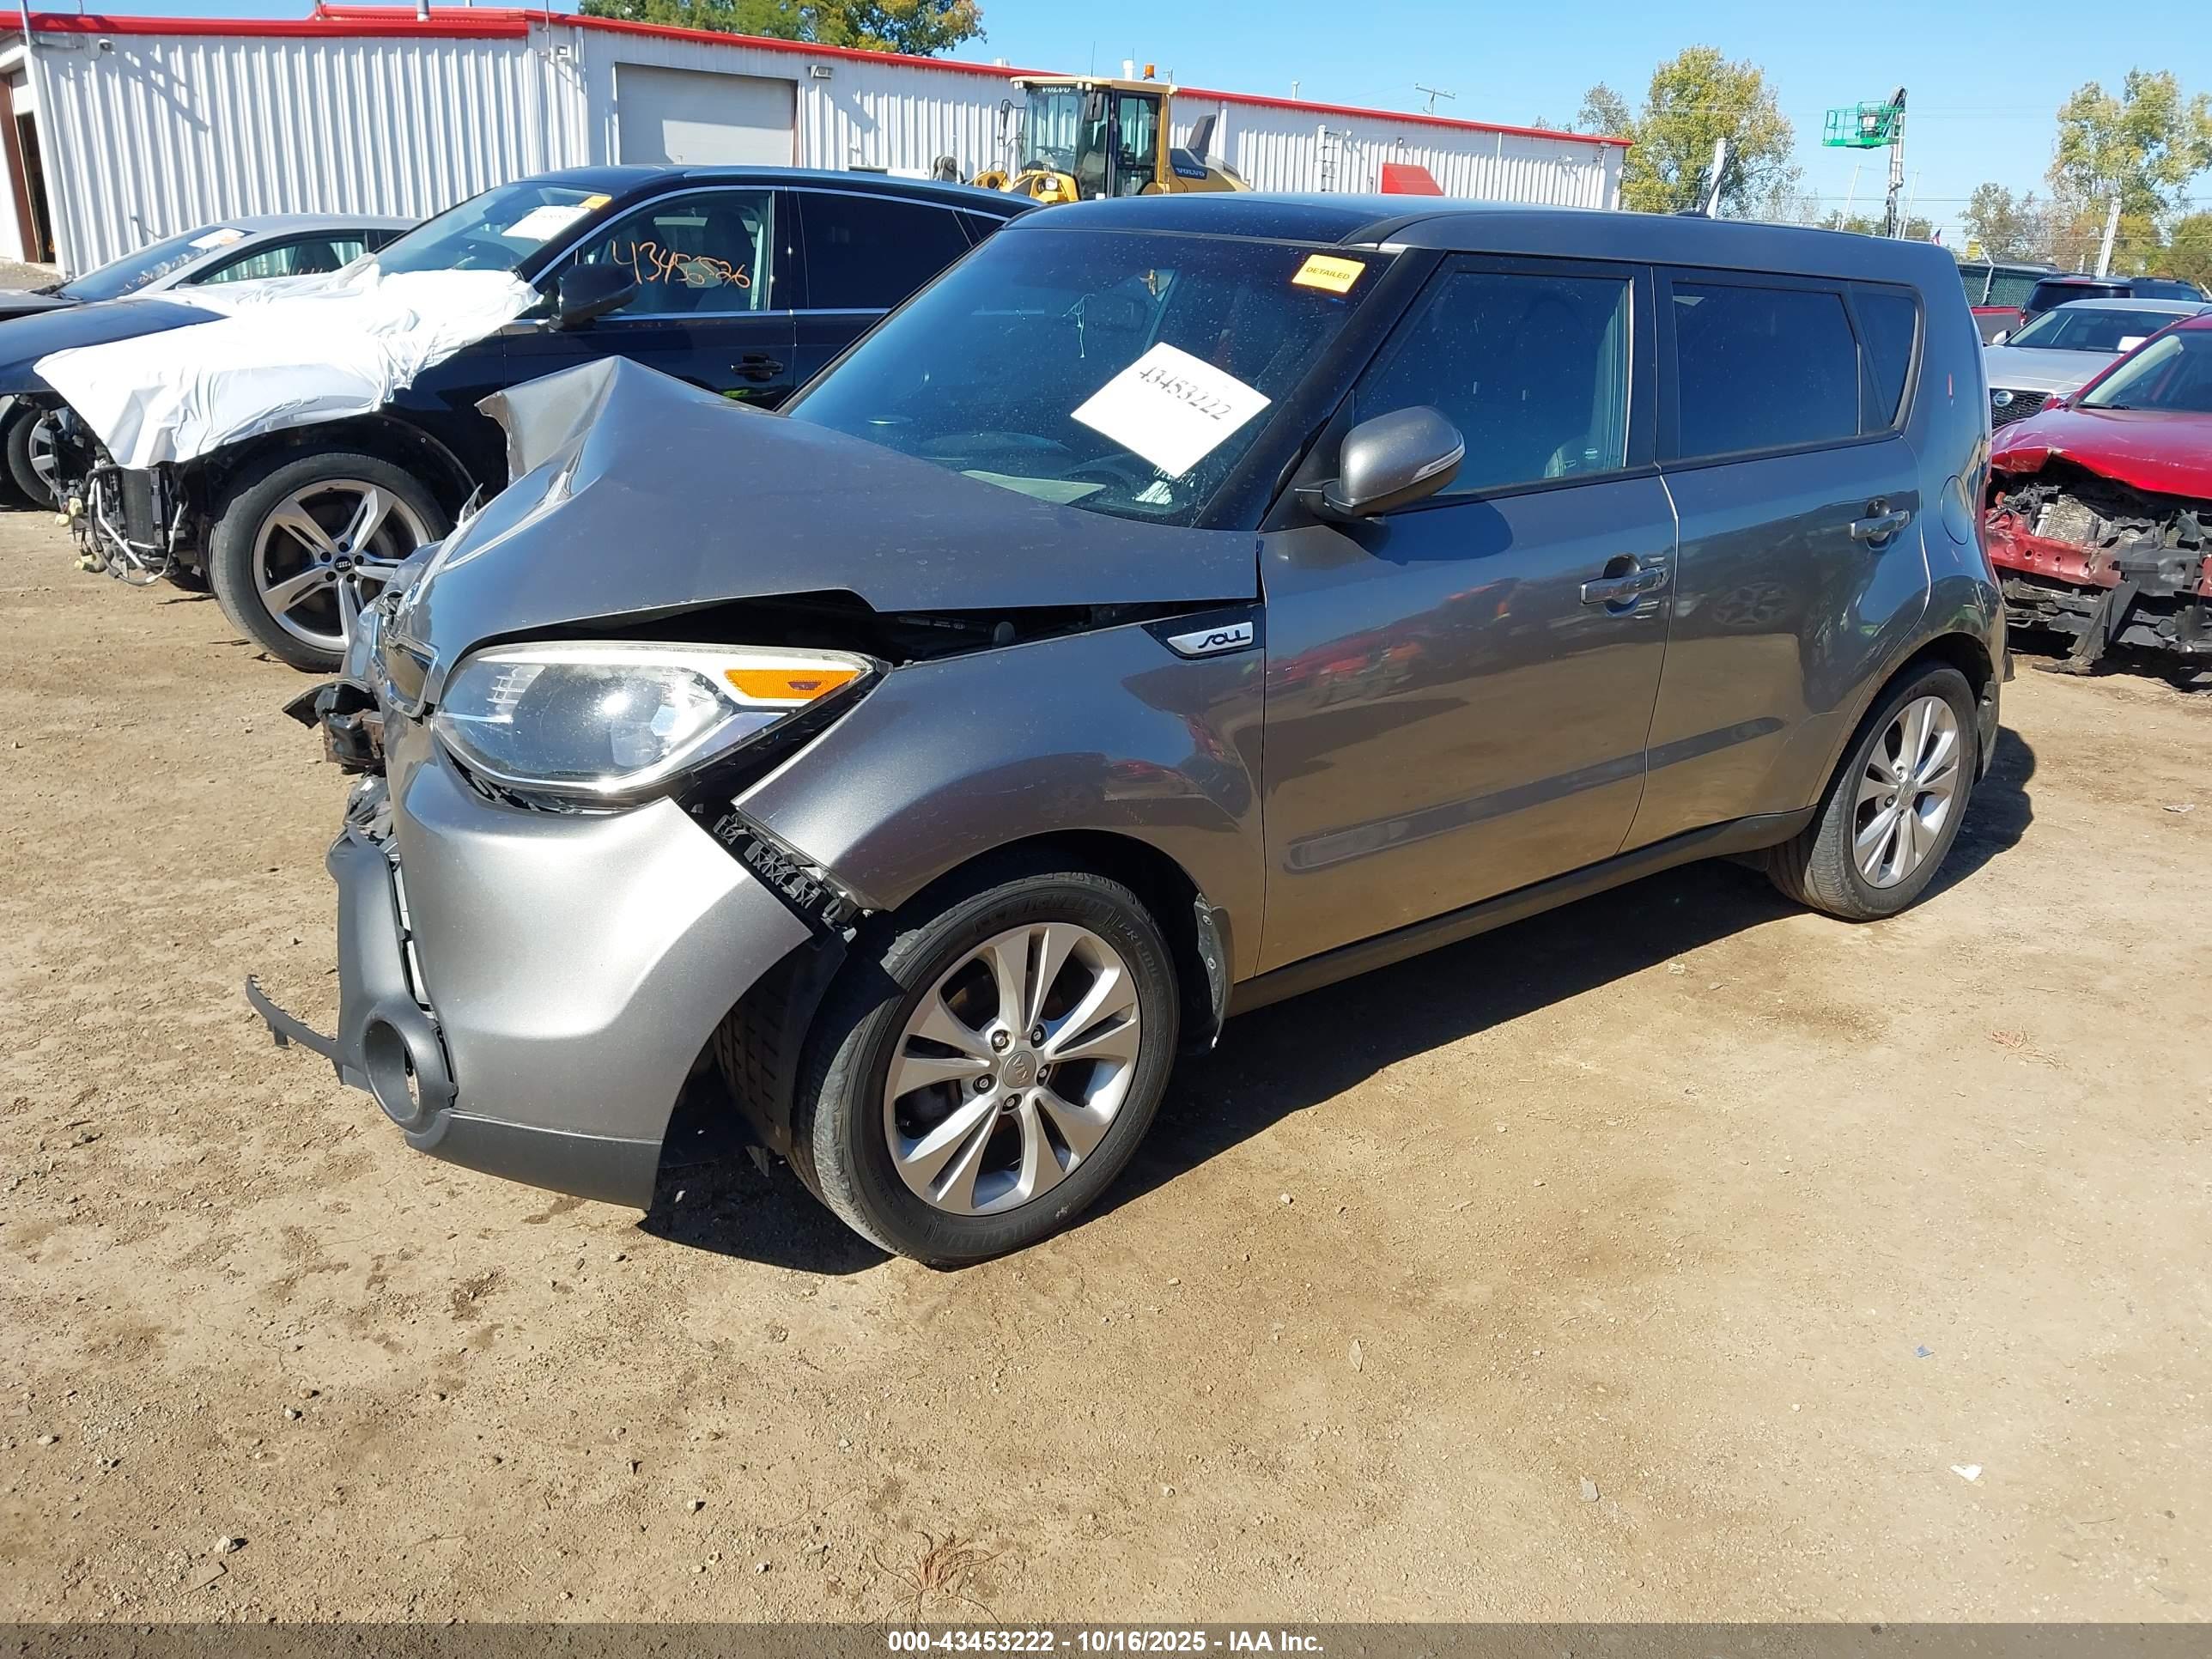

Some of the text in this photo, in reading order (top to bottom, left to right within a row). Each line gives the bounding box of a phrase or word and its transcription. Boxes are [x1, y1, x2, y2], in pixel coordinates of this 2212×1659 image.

[1176, 167, 1206, 177] VOLVO
[1305, 266, 1351, 280] DETAILED
[1139, 366, 1231, 421] 43453222
